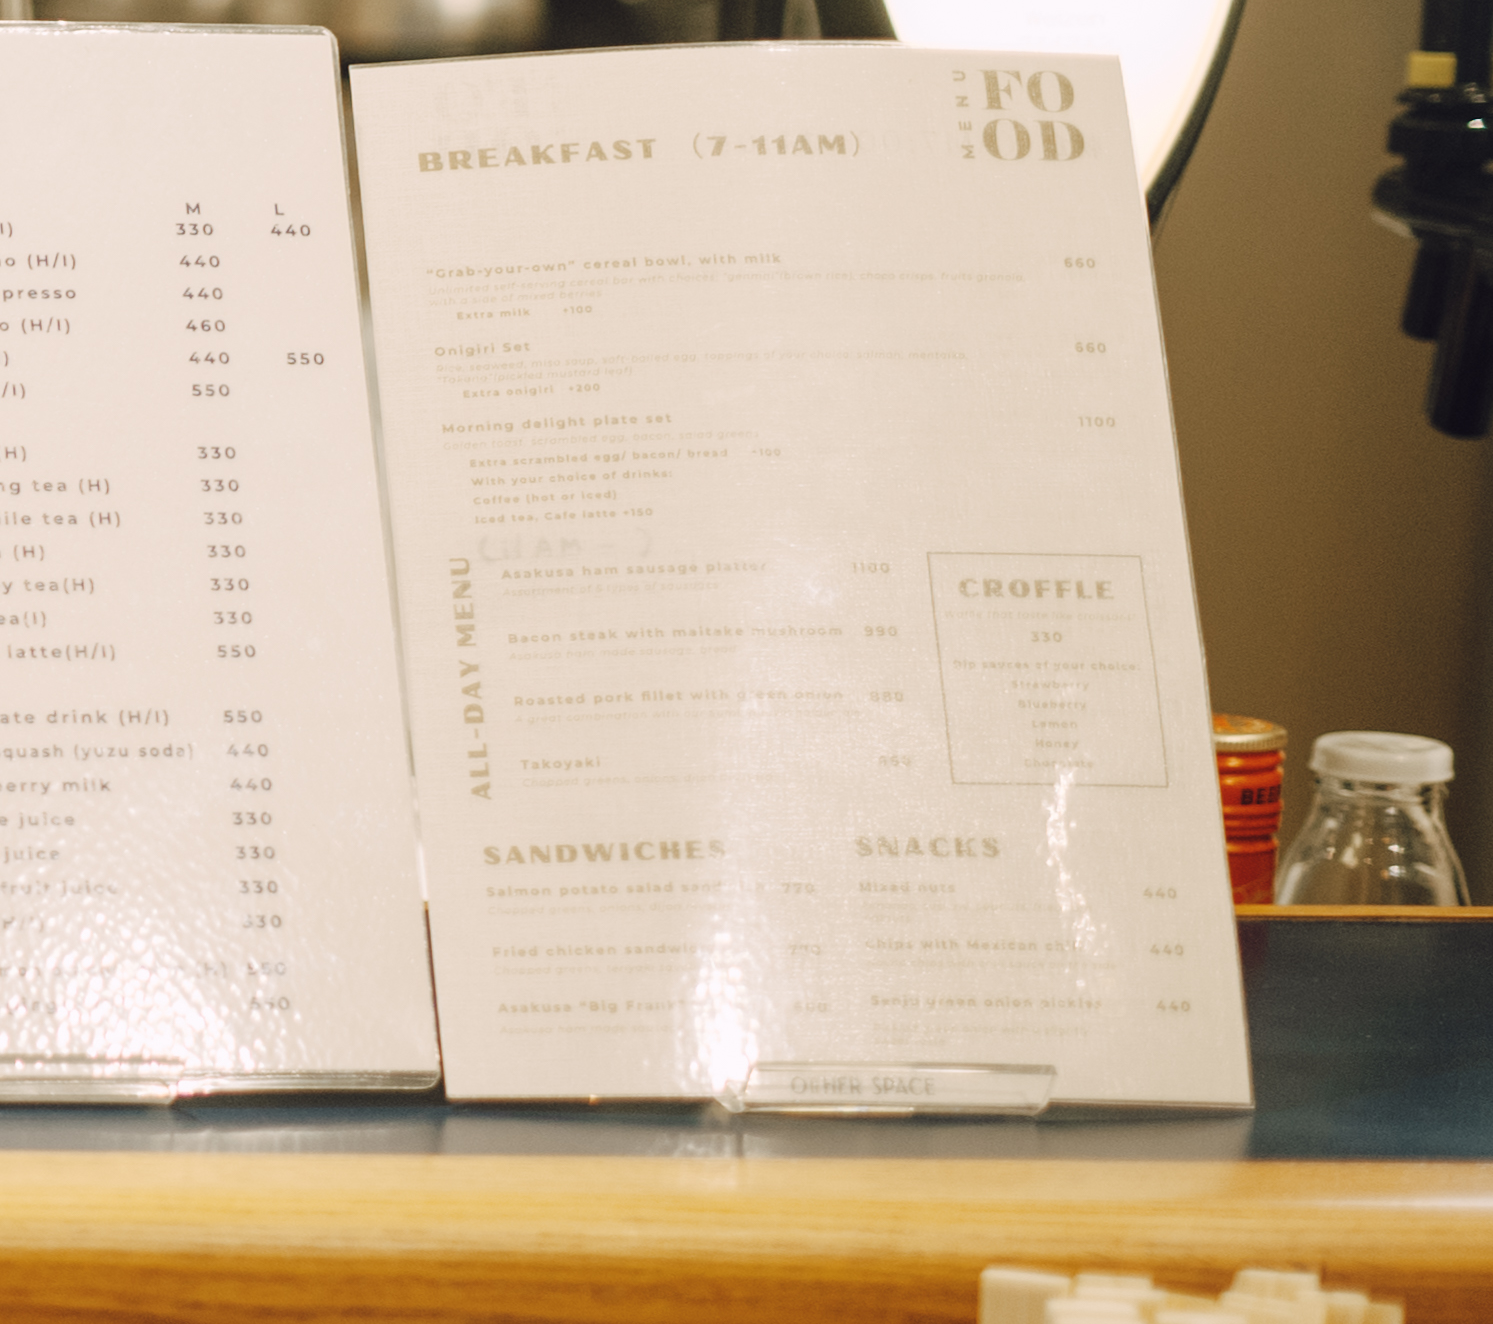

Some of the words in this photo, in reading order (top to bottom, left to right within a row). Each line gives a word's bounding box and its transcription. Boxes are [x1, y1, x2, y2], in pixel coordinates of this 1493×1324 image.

[983, 69, 1075, 113] FO
[952, 70, 975, 159] MENU
[982, 119, 1086, 162] OD
[418, 138, 656, 174] BREAKFAST
[185, 202, 201, 215] M
[273, 202, 285, 217] L
[177, 222, 214, 237] 330
[270, 223, 312, 238] 440
[26, 252, 77, 272] (H/I)
[179, 254, 221, 269] 440
[182, 286, 224, 301] 440
[449, 557, 477, 647] MENU
[956, 578, 1114, 601] CROFFLE
[459, 659, 492, 800] ALL-DAY
[61, 779, 111, 793] milk
[230, 776, 273, 793] 440
[483, 840, 729, 866] SANDWICHES
[850, 831, 1001, 860] SNACKS
